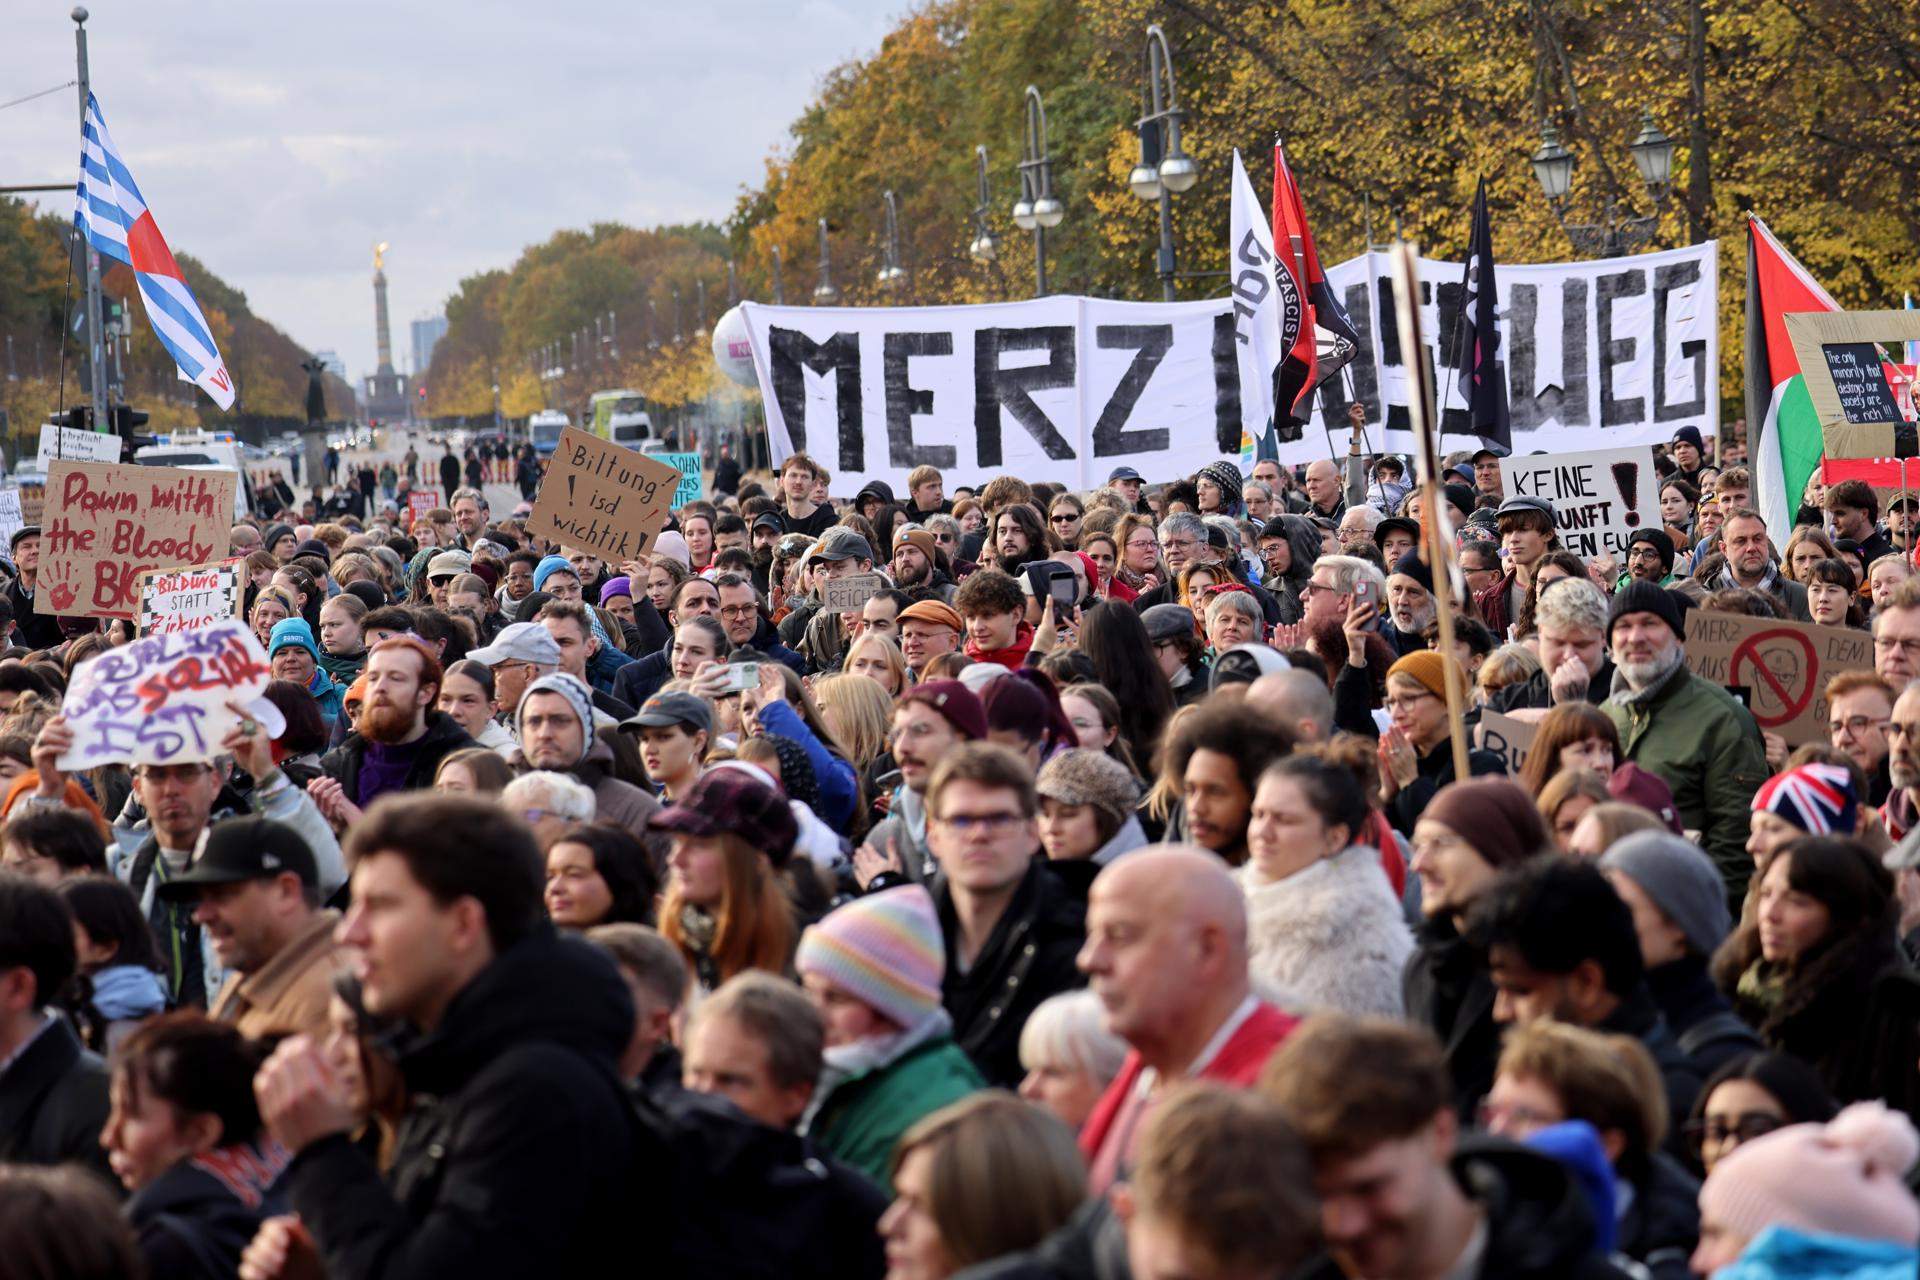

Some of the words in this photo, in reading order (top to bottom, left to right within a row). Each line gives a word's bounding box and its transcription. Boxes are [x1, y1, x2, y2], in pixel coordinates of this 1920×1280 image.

[768, 323, 1174, 473] MERZ
[1510, 259, 1708, 433] WEG
[1825, 350, 1841, 364] The
[1841, 351, 1856, 366] only
[1833, 365, 1865, 383] minority
[1865, 363, 1882, 377] that
[1837, 382, 1865, 397] destroys
[1866, 383, 1878, 393] our
[1842, 395, 1866, 409] society
[1866, 395, 1882, 406] are
[1846, 410, 1859, 422] the
[1863, 408, 1883, 420] rich
[571, 444, 657, 504] Biltung
[670, 455, 700, 474] SOHN
[63, 471, 138, 515] Down
[151, 475, 214, 518] with
[1512, 464, 1598, 501] KEINE
[589, 490, 622, 517] isd
[1554, 501, 1612, 531] UNFT
[44, 517, 97, 555] the
[112, 519, 214, 566] Bloody
[1565, 532, 1598, 558] EN
[1603, 531, 1632, 555] EU
[171, 591, 213, 611] STATT
[1688, 618, 1742, 643] MERZ
[1825, 637, 1866, 664] DEM
[84, 702, 206, 760] IST
